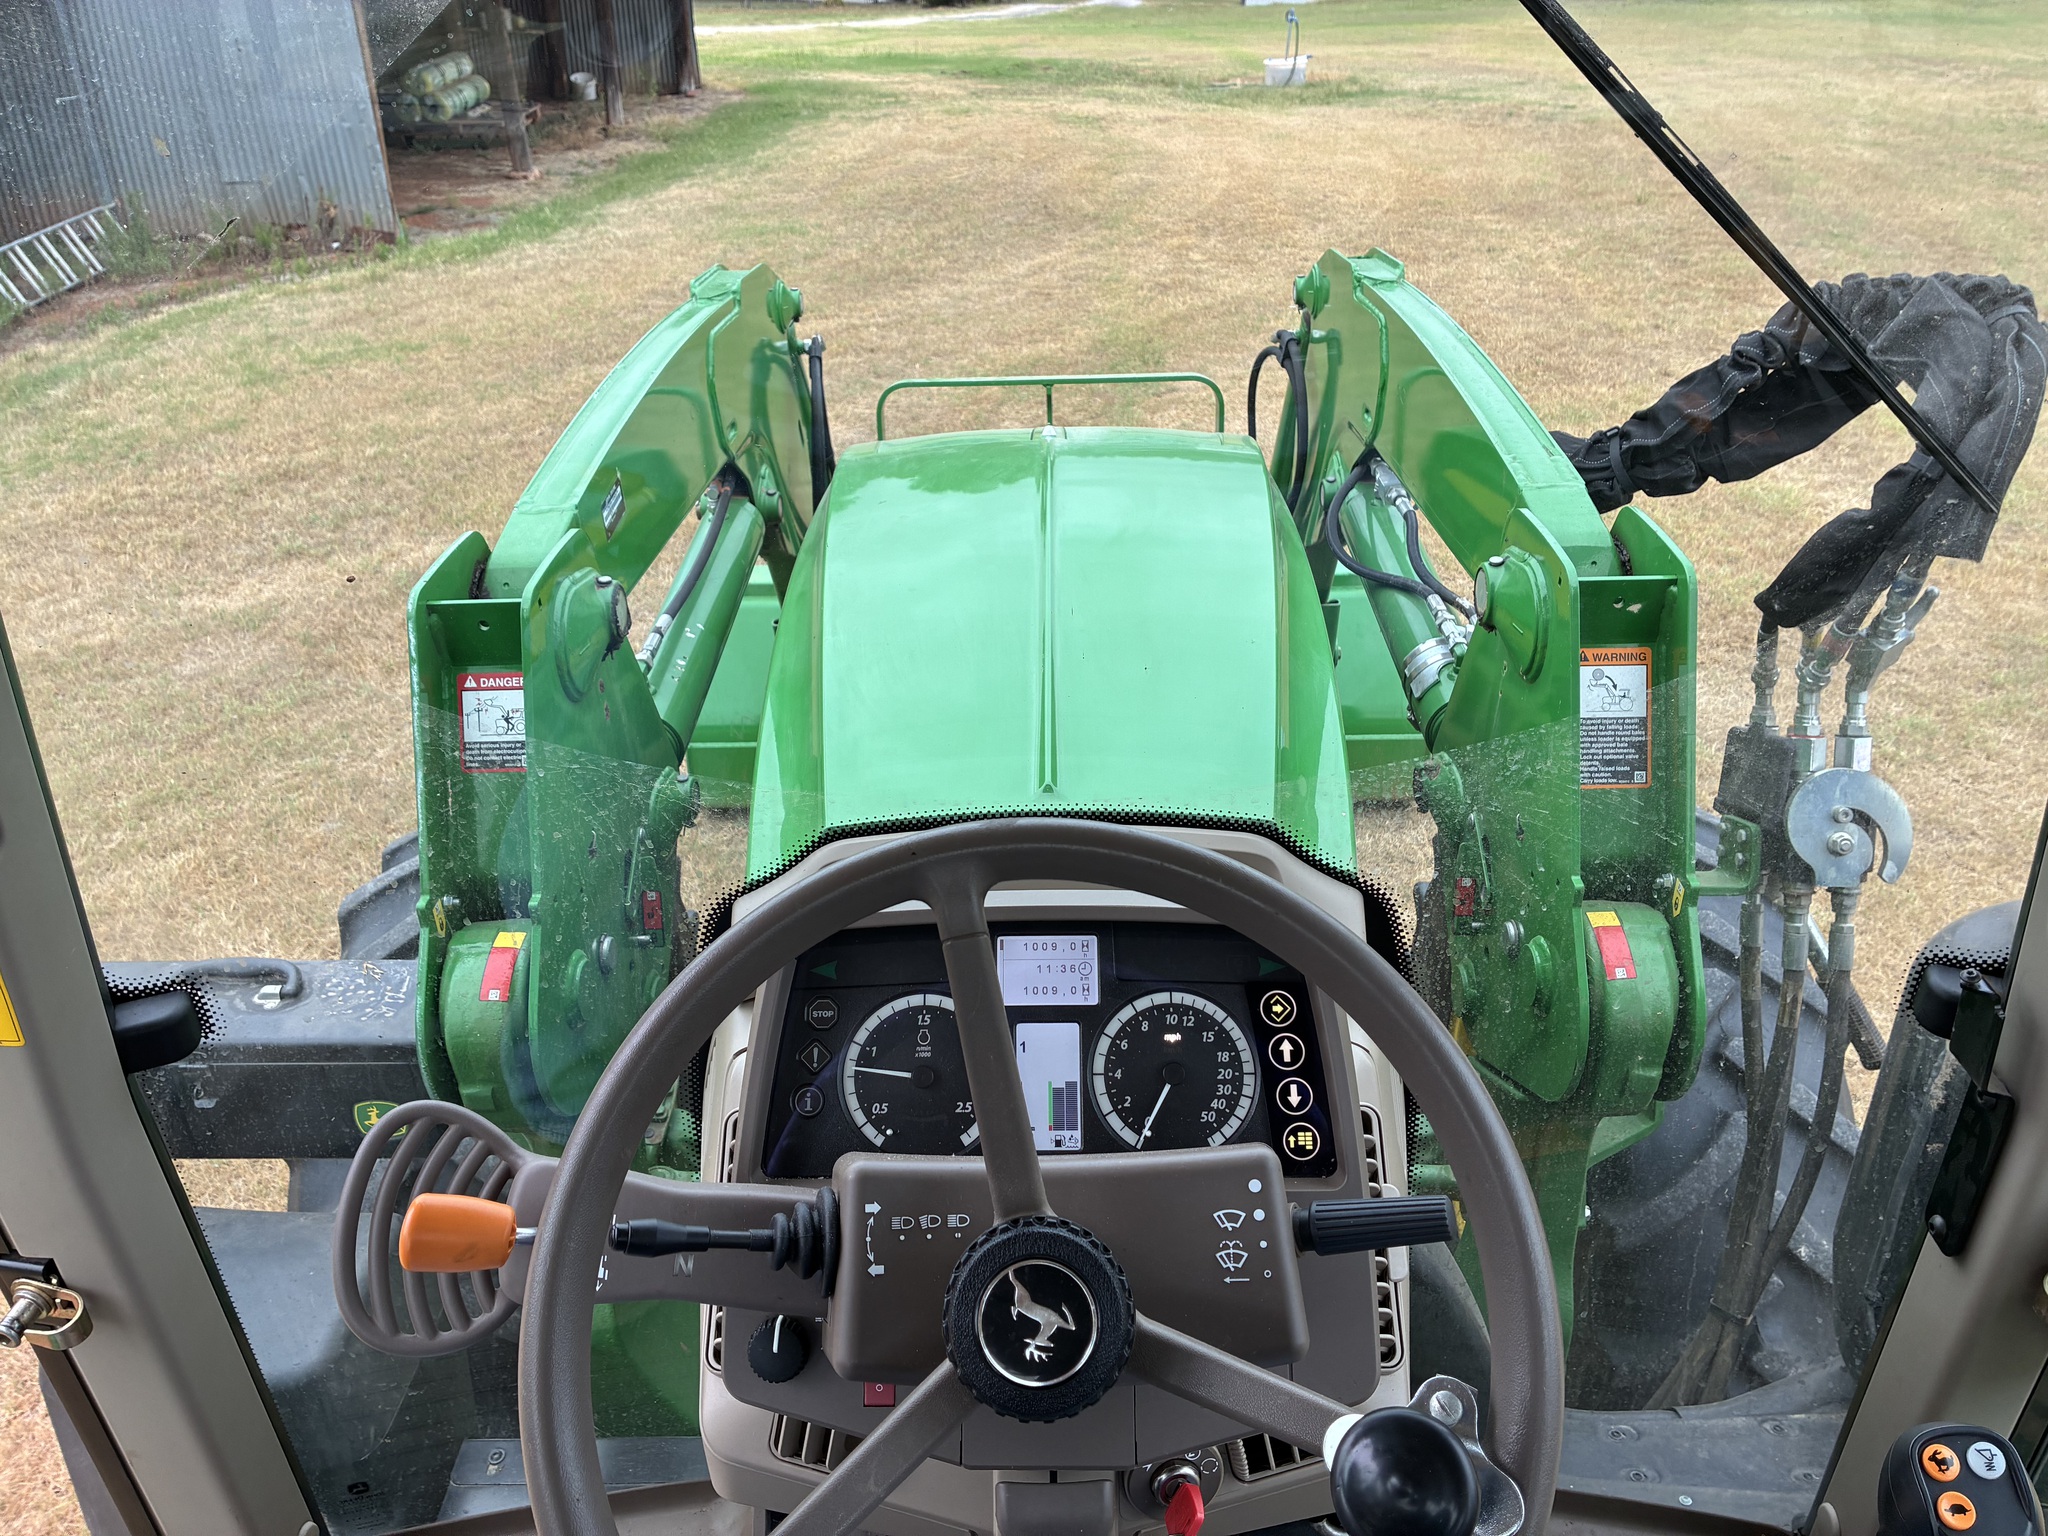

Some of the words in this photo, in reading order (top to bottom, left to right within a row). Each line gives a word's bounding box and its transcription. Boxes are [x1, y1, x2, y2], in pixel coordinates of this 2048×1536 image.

[1592, 652, 1646, 662] WARNING
[1037, 964, 1076, 973] 11:36
[917, 1014, 931, 1025] 1.5
[1166, 1014, 1178, 1025] 10
[1182, 1016, 1195, 1026] 12
[1141, 1021, 1149, 1032] 8
[1164, 1032, 1181, 1042] mph
[1201, 1031, 1215, 1042] 15
[1020, 1041, 1026, 1053] 1
[1120, 1039, 1128, 1050] 6
[870, 1046, 877, 1056] 1
[1216, 1051, 1229, 1062] 18
[1114, 1068, 1122, 1079] 4
[1217, 1068, 1233, 1079] 20
[1216, 1084, 1232, 1095] 30
[1124, 1096, 1131, 1107] 2
[1210, 1099, 1226, 1110] 40
[872, 1103, 888, 1114] 0.5
[955, 1102, 972, 1113] 2.5
[1200, 1112, 1216, 1122] 50
[673, 1253, 694, 1276] N
